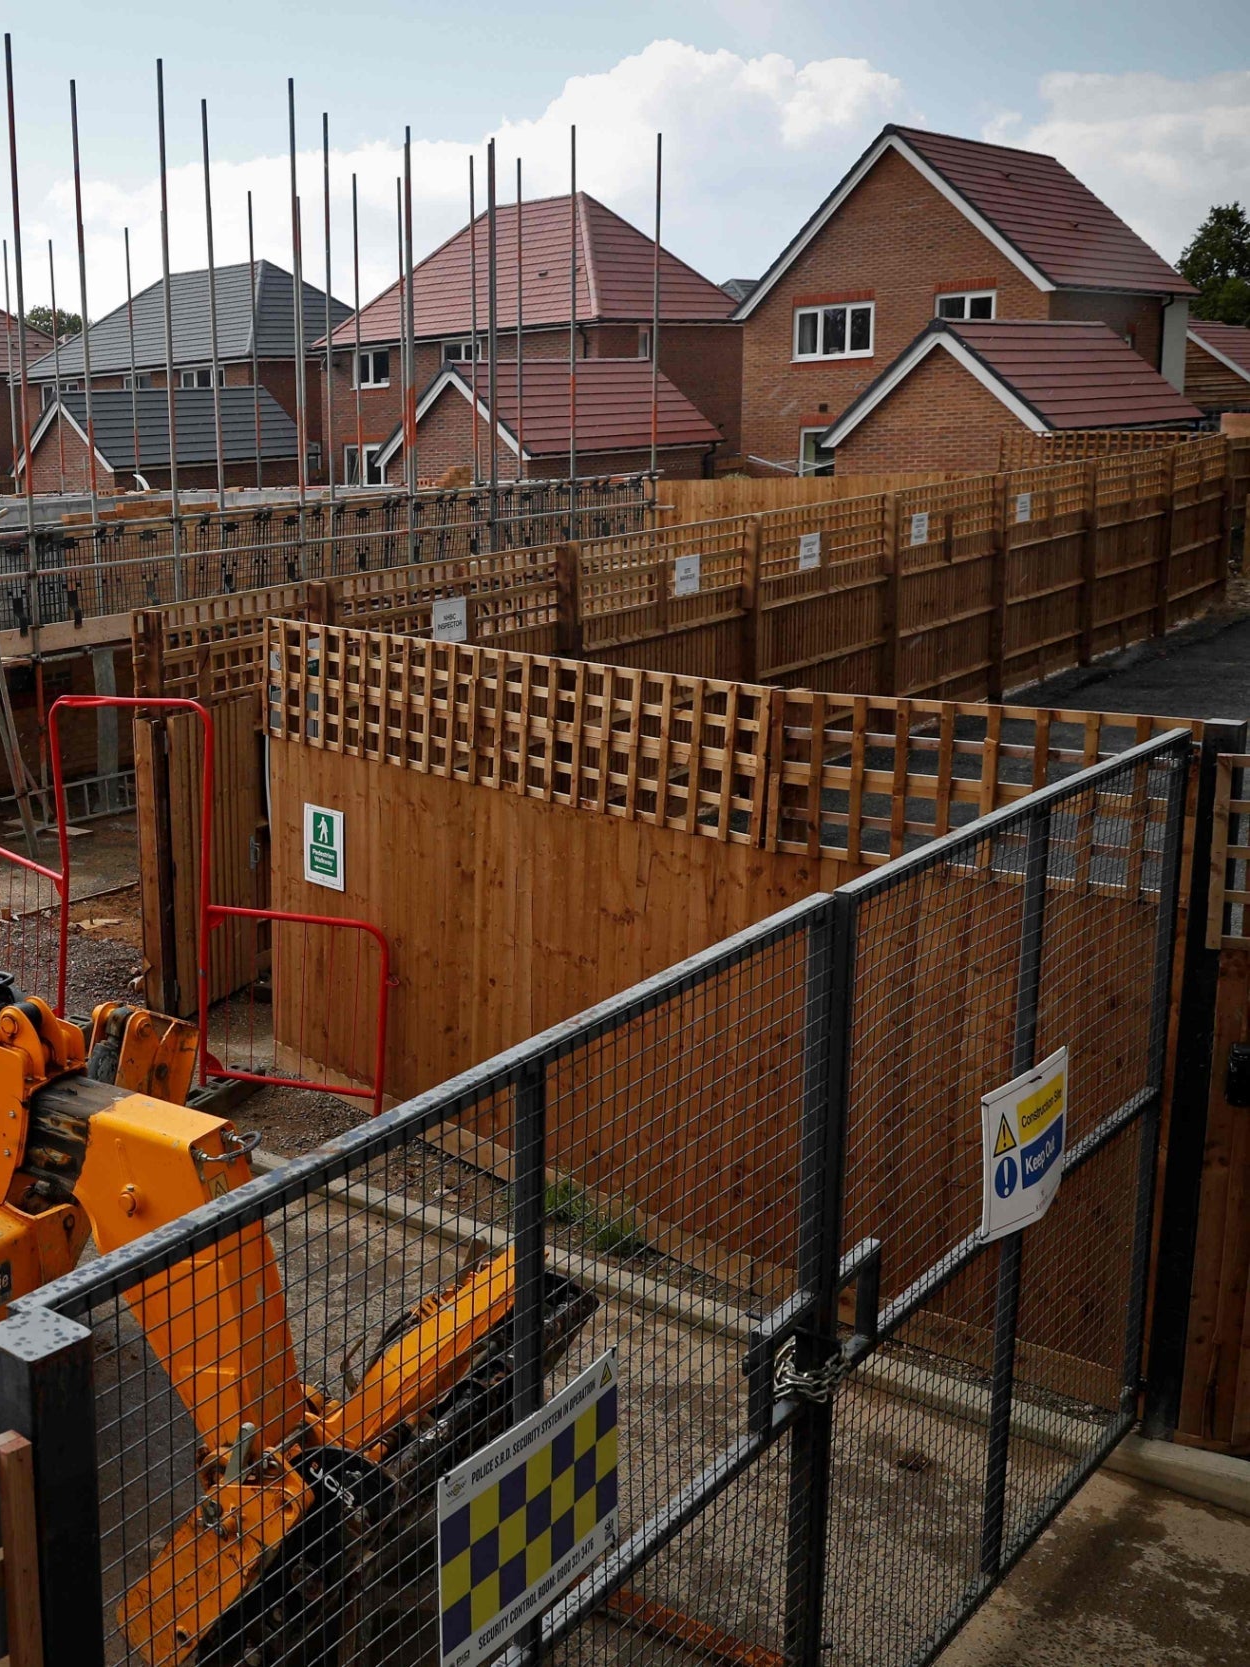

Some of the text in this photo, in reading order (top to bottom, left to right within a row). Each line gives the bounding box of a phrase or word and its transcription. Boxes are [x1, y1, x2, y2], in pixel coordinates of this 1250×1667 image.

[437, 620, 462, 630] INSPECTOR
[1021, 1097, 1054, 1128] Construction
[1025, 1149, 1046, 1175] Keep
[1045, 1135, 1056, 1158] Out
[471, 1459, 494, 1486] POLICE
[512, 1424, 541, 1456] SECURITY
[541, 1406, 562, 1434] SYSTEM
[562, 1400, 569, 1417] IN
[569, 1379, 596, 1411] OPERATION
[310, 1466, 355, 1506] JCB
[478, 1614, 509, 1650] SECURITY
[509, 1591, 537, 1624] CONTROL
